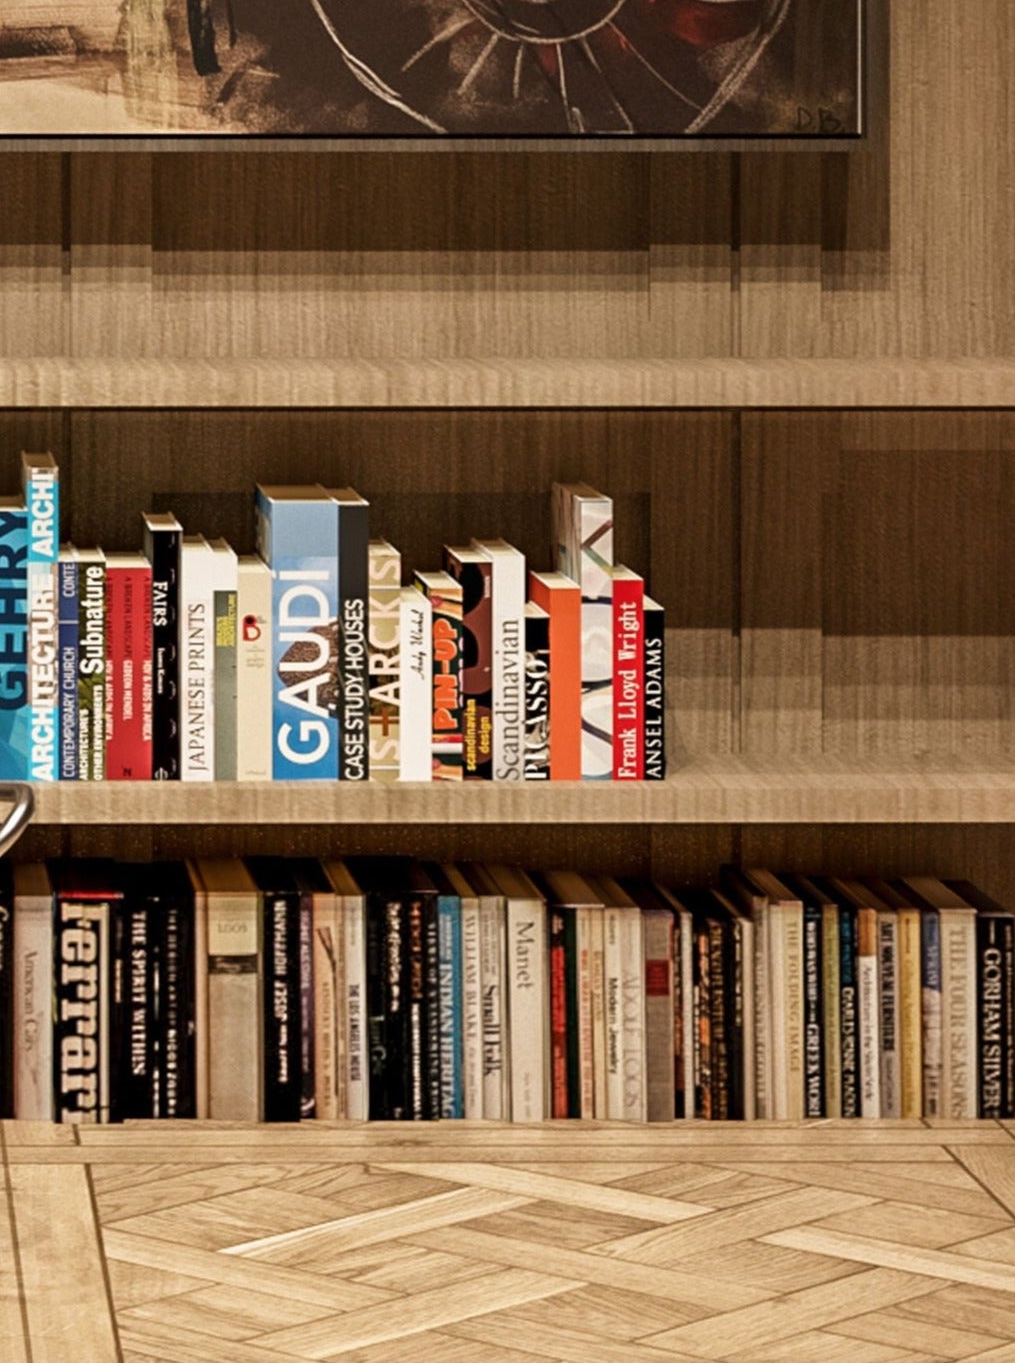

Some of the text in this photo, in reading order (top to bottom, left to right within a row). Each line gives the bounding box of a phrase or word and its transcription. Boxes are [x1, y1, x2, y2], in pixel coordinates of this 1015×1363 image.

[80, 566, 103, 674] Subnature
[153, 581, 168, 626] FAIRS
[31, 573, 55, 781] ARCHITECTURE
[411, 608, 425, 680] Andy Warhol
[432, 618, 458, 729] PIN-UP
[64, 647, 75, 777] CONTEMPORARY CHURCH
[188, 604, 209, 771] JAPANESE PRINTS
[345, 598, 364, 781] CASE STUDY HOUSES
[495, 620, 519, 780] Scandinavian
[524, 659, 548, 779] PICASSO
[618, 601, 640, 778] Frank Lloyd Wright
[646, 638, 662, 778] ANSEL ADAMS
[95, 753, 103, 781] OTHER
[465, 699, 477, 771] scandinavian
[478, 716, 492, 754] design
[273, 900, 288, 976] HOFFMANN
[465, 915, 476, 985] WILLIAM
[516, 921, 535, 990] Manet
[808, 922, 817, 948] WHO
[880, 922, 895, 943] ART
[882, 946, 895, 991] NOUVEAU
[24, 948, 38, 1053] American Cars
[131, 911, 146, 1076] THE SPIRIT WITHIN
[349, 984, 360, 997] THE
[349, 1000, 360, 1015] LOS
[440, 964, 455, 1033] INDIAN
[465, 991, 477, 1042] BLAKE
[483, 984, 502, 1035] Small
[608, 977, 619, 1075] Modern Jewelry
[788, 921, 799, 1073] THE FOLDING IMAGE
[882, 995, 896, 1052] FURNITURE
[950, 927, 969, 1118] THE FOUR SEASONS
[349, 1018, 361, 1053] ANGELES
[484, 1039, 502, 1077] Folk
[623, 969, 641, 1108] ADOLF LOOS
[807, 1024, 819, 1074] GREEK
[983, 948, 1002, 1108] GORHAM SILVER
